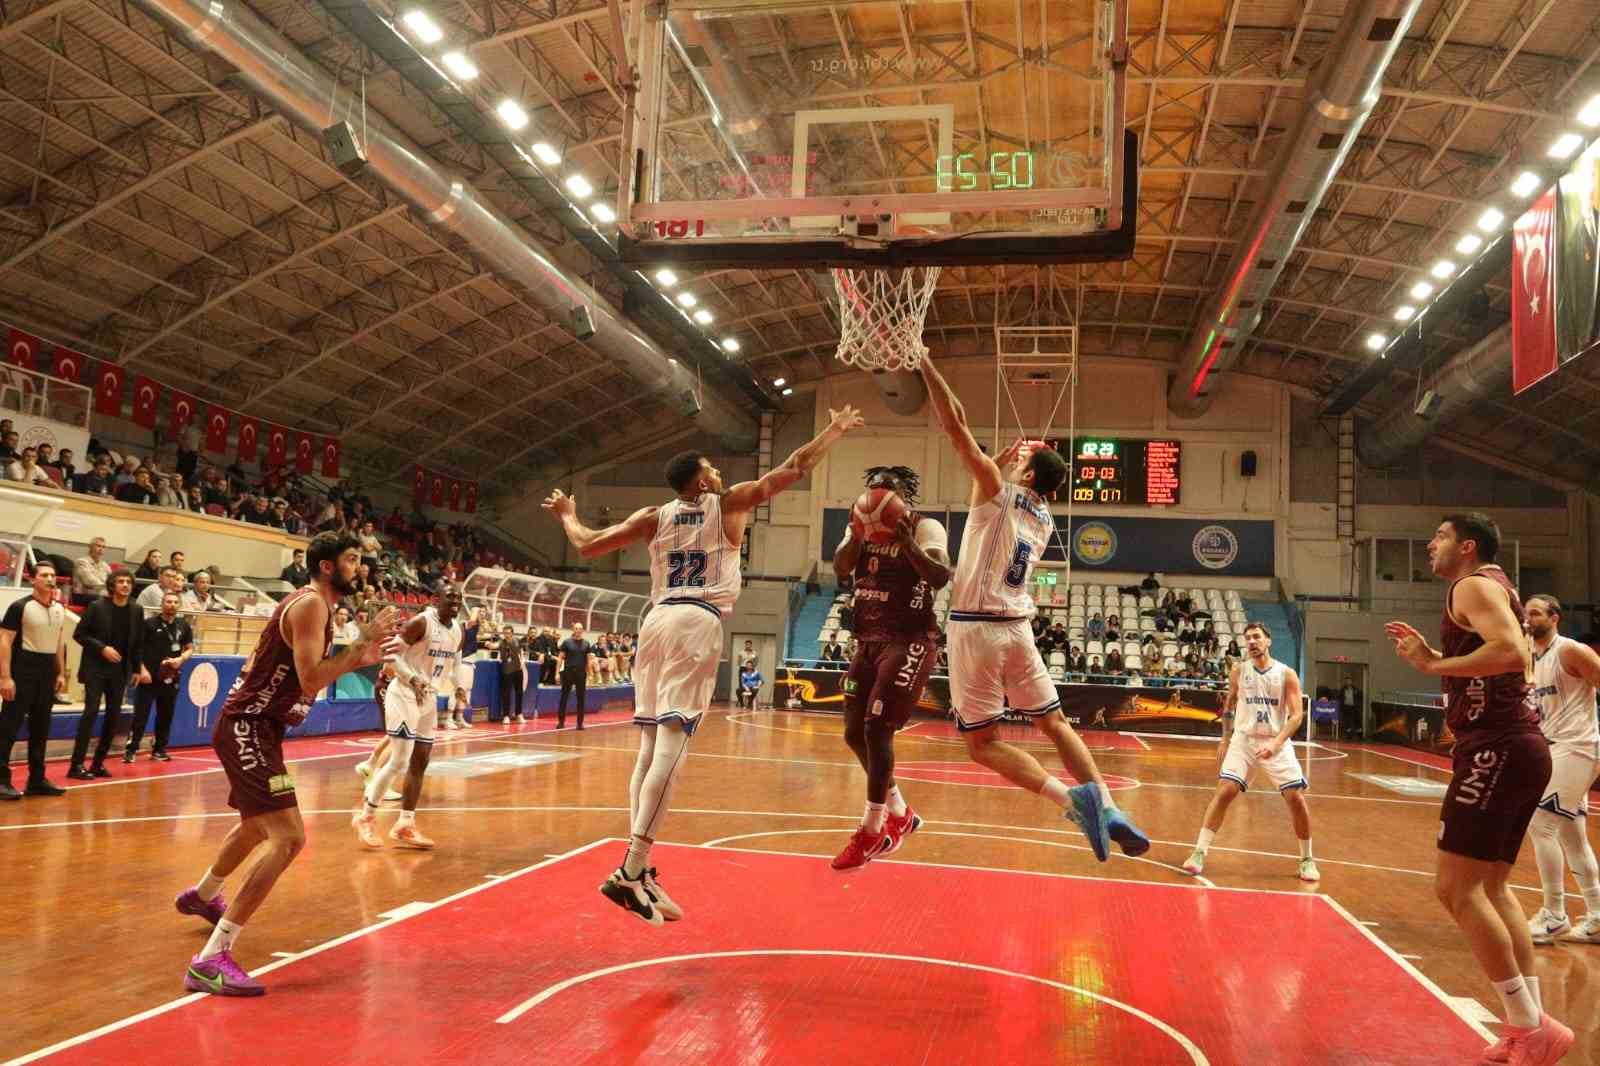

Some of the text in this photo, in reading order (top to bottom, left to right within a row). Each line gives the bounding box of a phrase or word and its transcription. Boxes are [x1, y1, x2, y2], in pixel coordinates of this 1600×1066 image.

[1081, 466, 1115, 480] 03 03
[667, 549, 707, 588] 22
[1004, 540, 1033, 588] 5
[244, 663, 291, 715] Sultan
[1455, 750, 1497, 805] UMG
